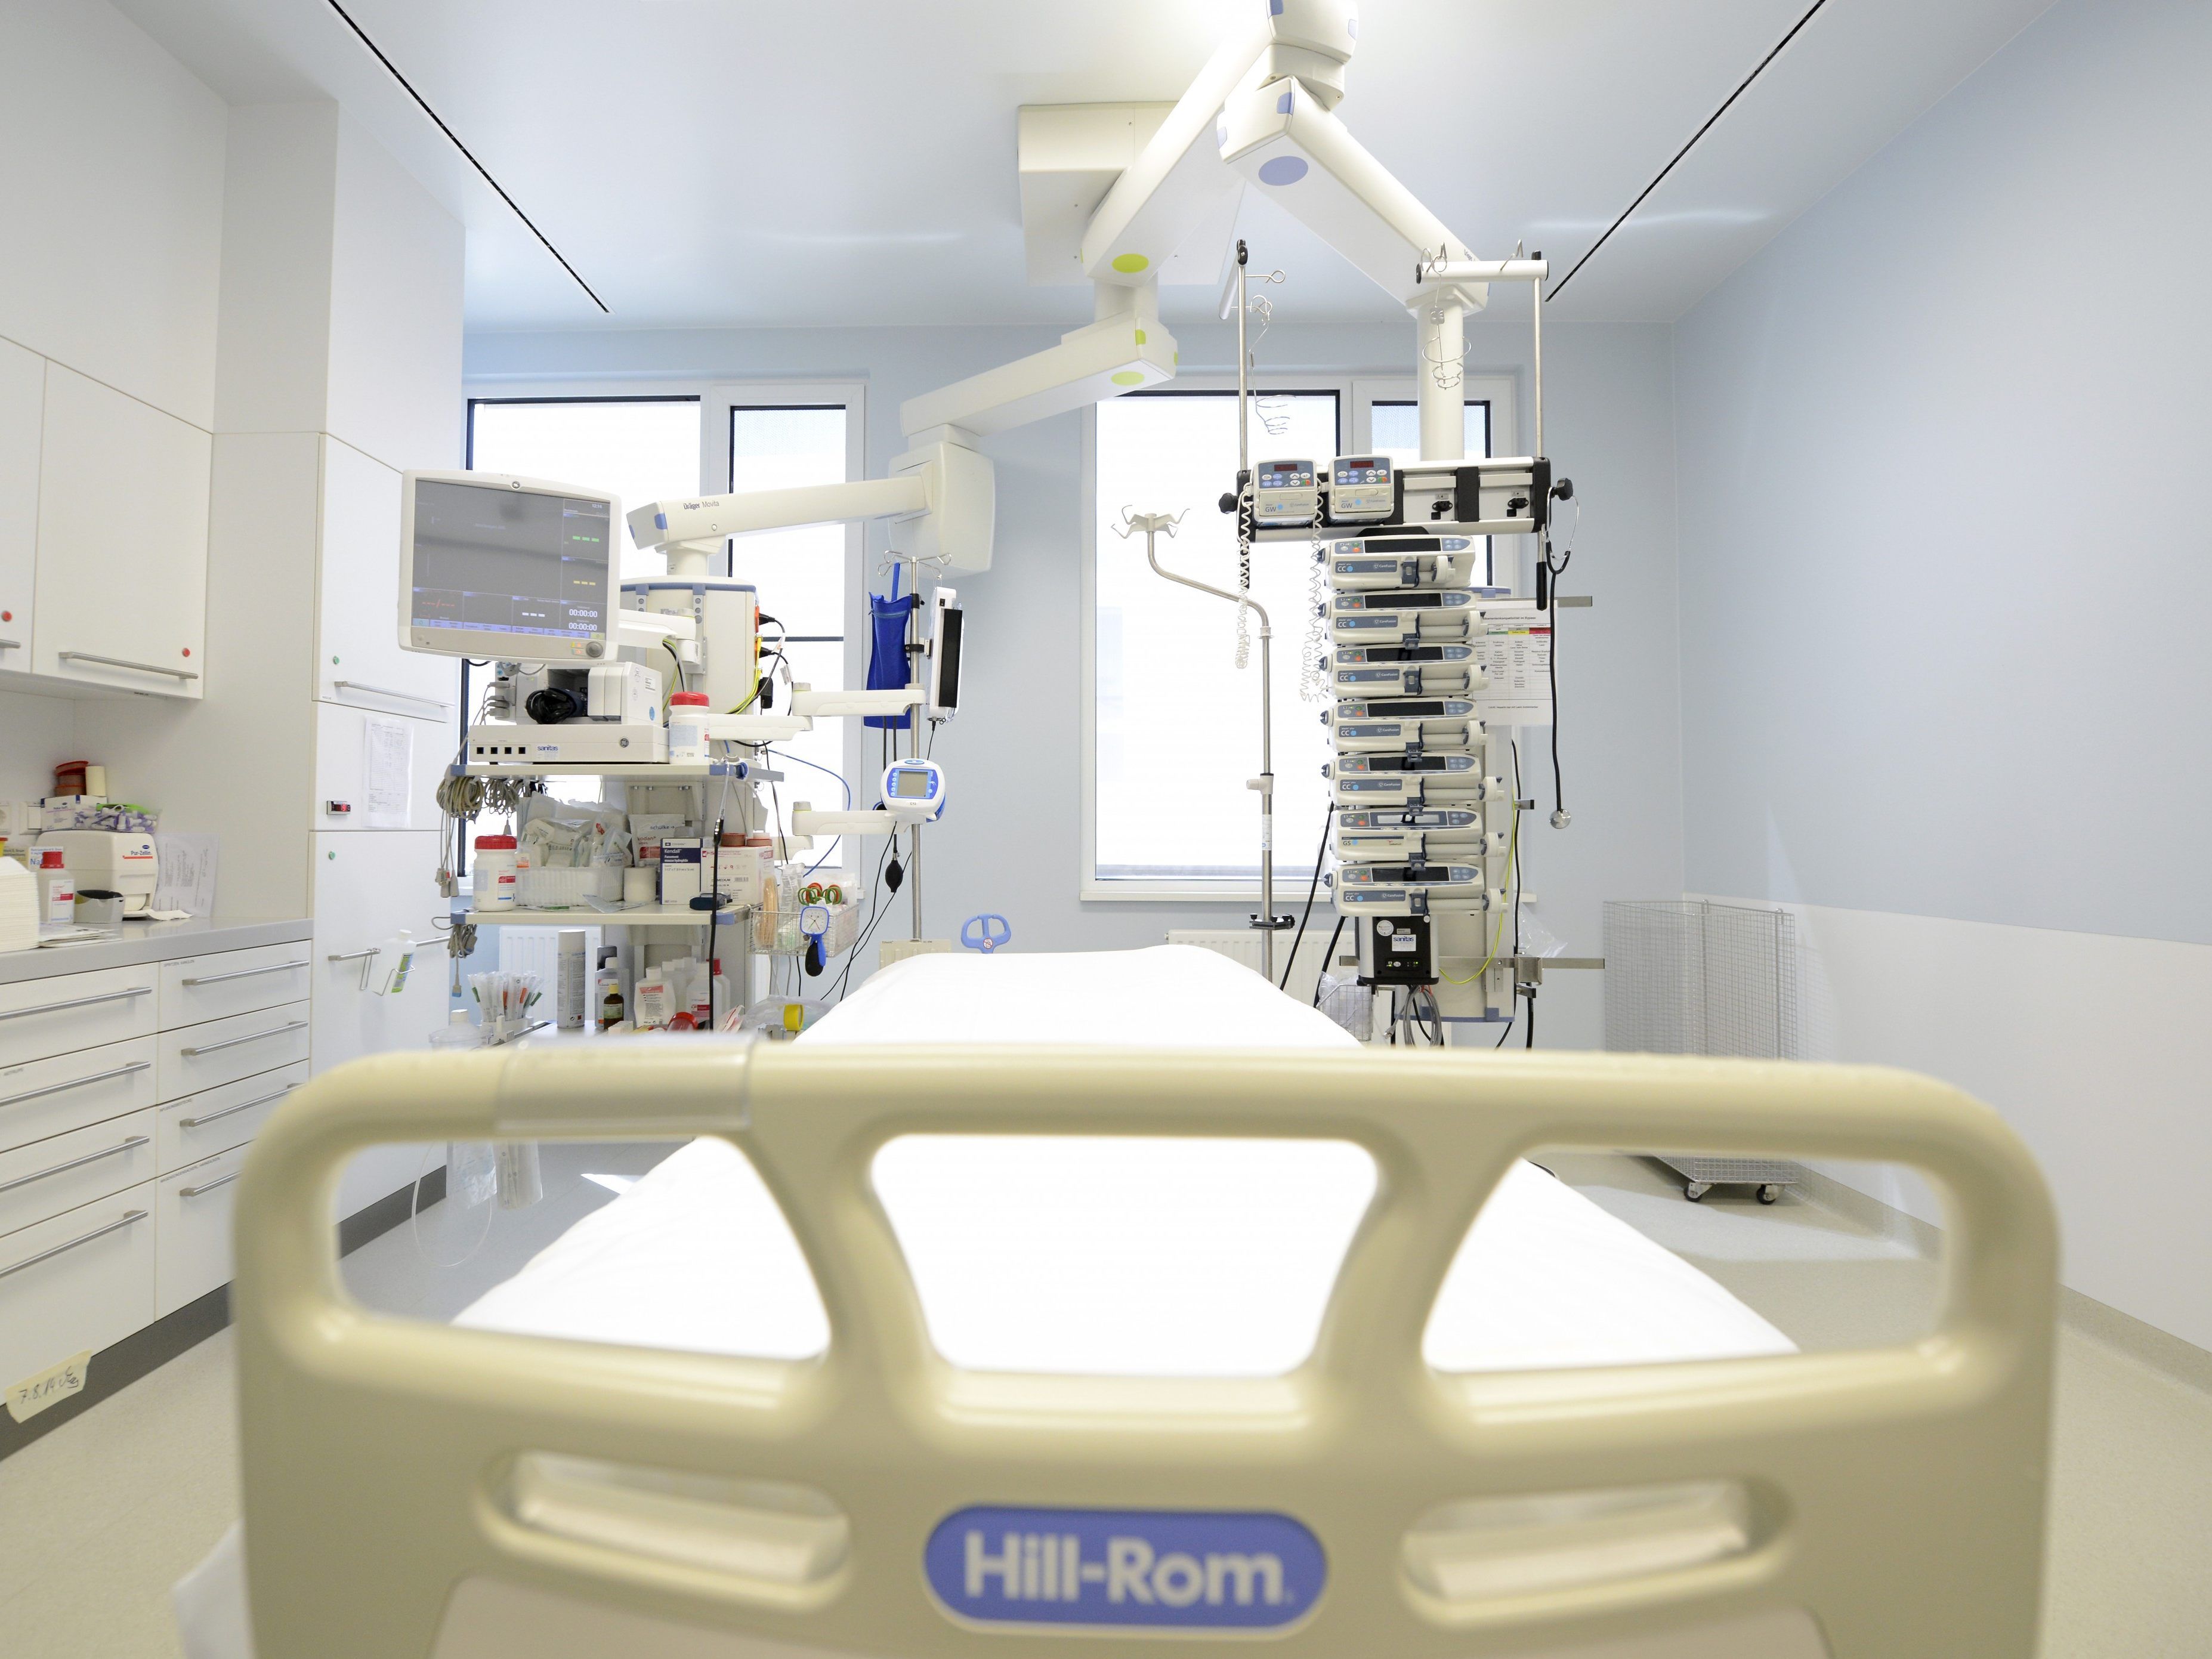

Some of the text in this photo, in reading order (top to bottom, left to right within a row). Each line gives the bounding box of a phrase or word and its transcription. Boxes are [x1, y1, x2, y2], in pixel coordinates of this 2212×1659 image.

[569, 609, 598, 618] 00:00:00
[569, 622, 597, 631] 00:00:00
[965, 1530, 1284, 1607] Hill-Rom
